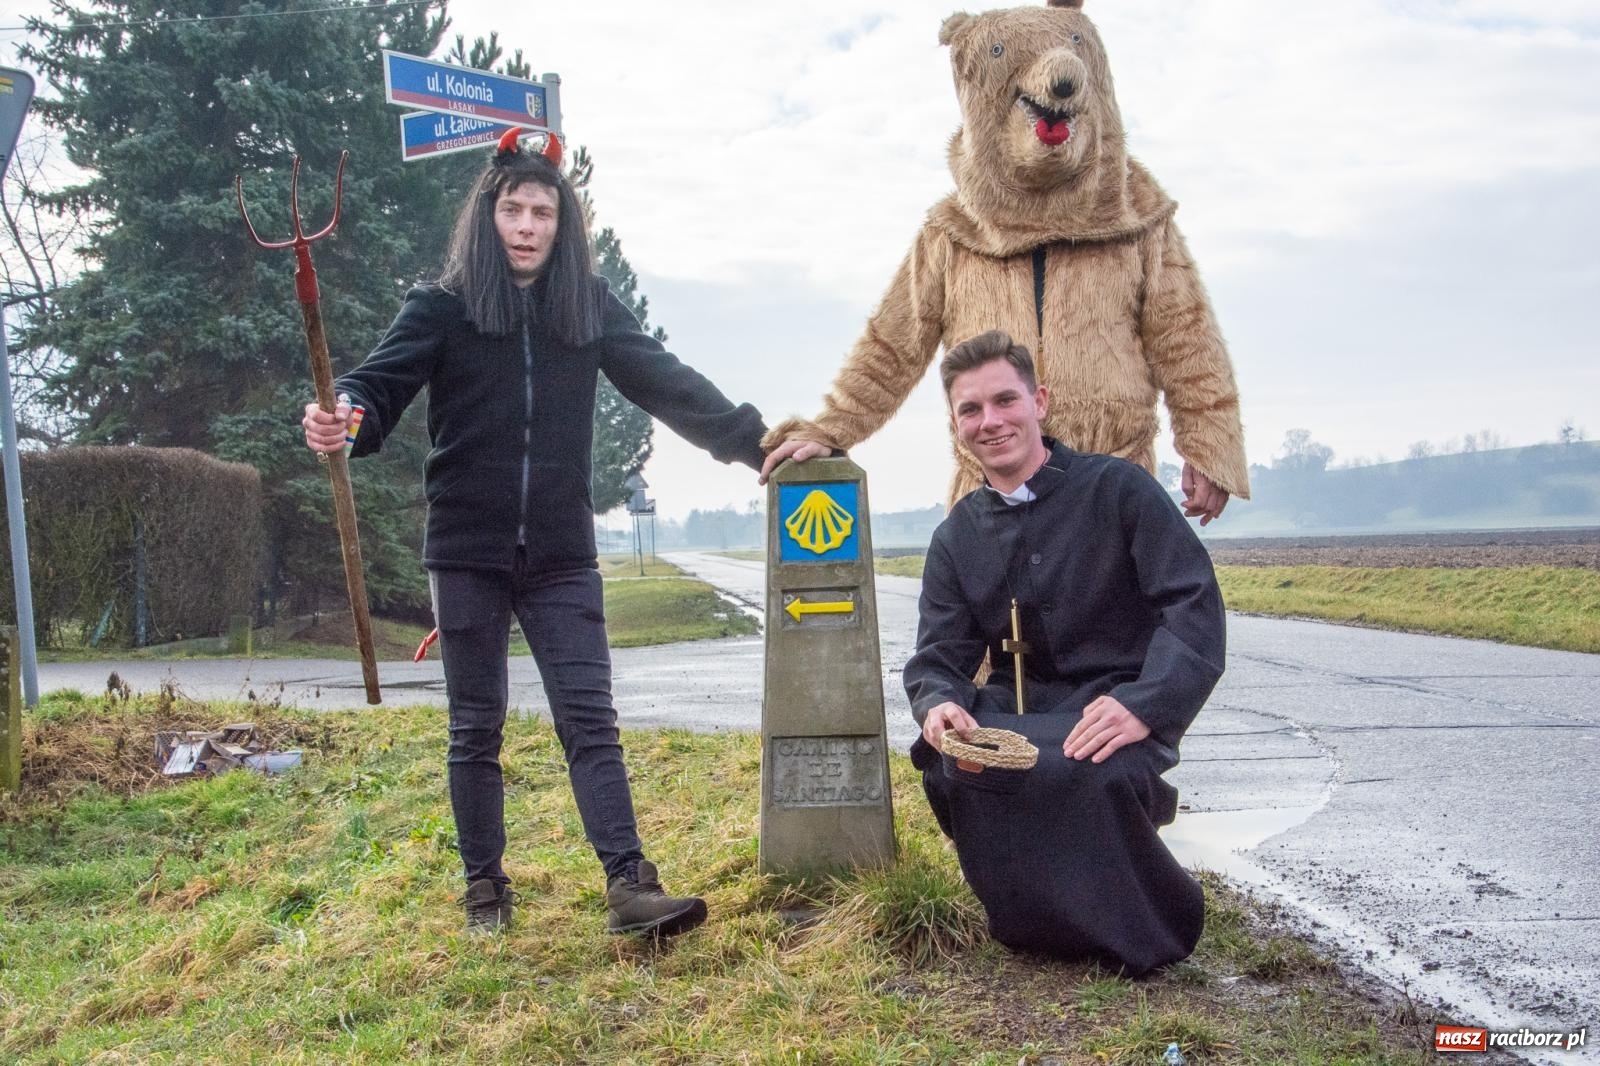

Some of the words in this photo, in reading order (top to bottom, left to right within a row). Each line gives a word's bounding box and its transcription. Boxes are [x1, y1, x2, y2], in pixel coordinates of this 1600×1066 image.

[427, 72, 442, 94] ul.
[446, 74, 494, 103] Kolonia
[434, 117, 448, 138] ul.
[436, 131, 494, 151] GRZEGORZOWICE
[779, 738, 875, 756] CAMINO
[808, 760, 842, 777] DE
[774, 785, 882, 803] SANTIAGO
